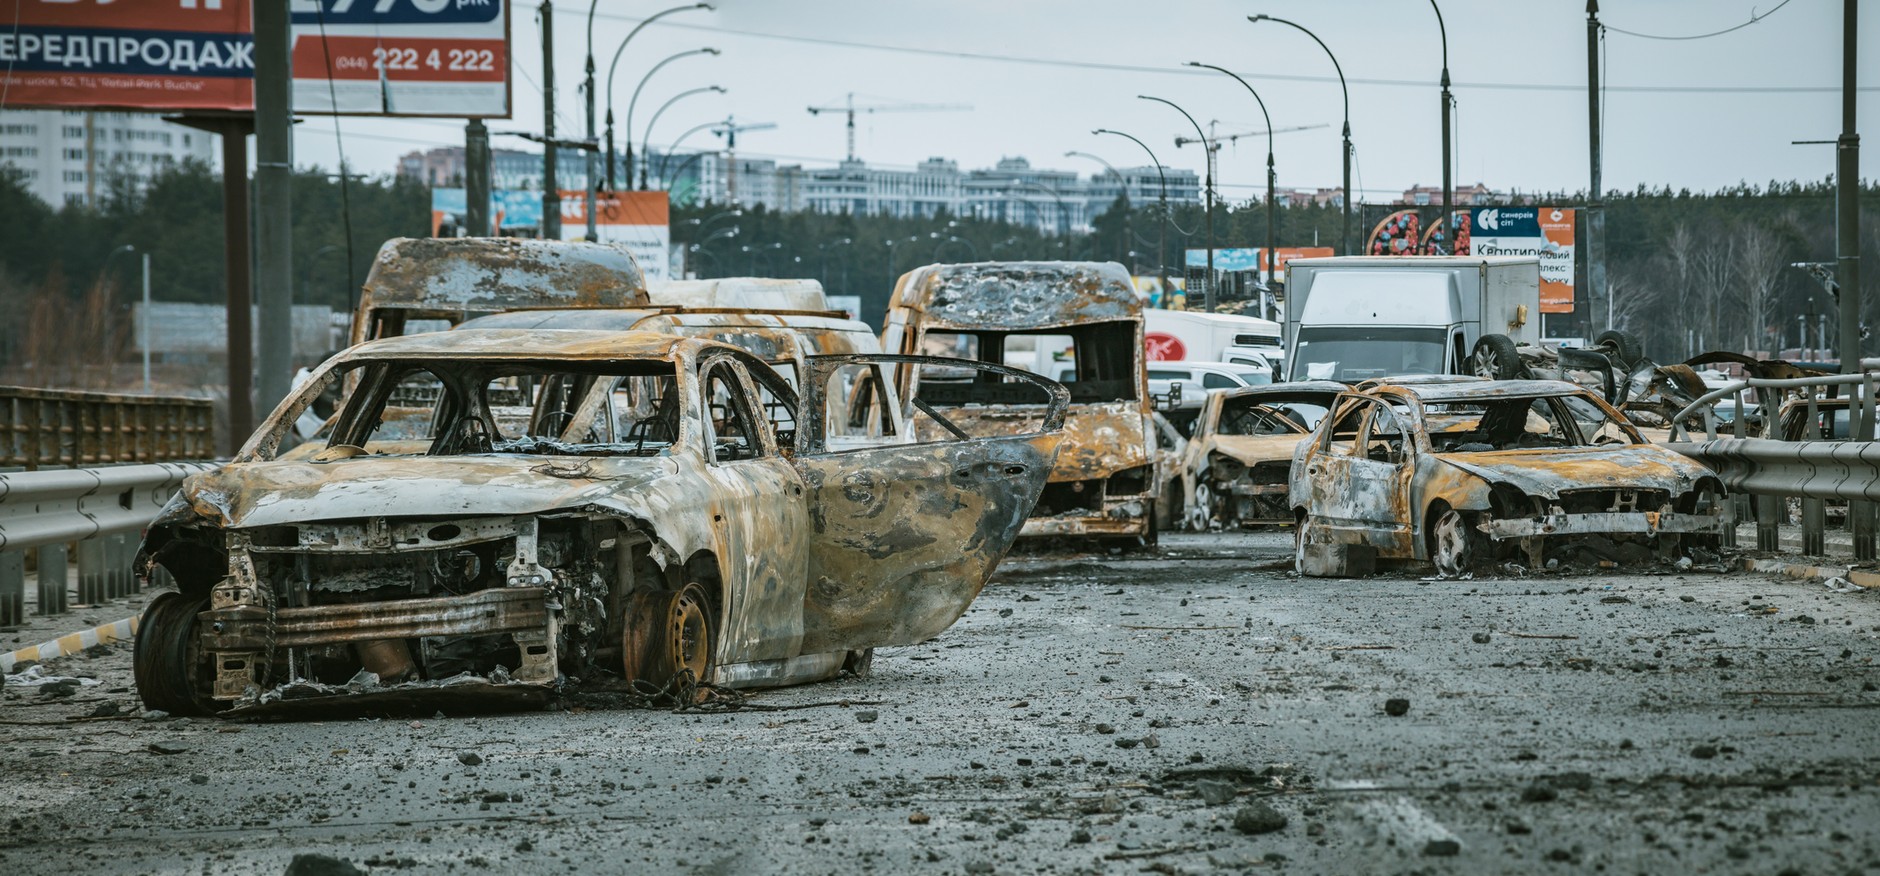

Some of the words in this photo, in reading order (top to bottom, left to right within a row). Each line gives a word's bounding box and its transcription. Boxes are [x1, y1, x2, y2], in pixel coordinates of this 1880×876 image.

[335, 56, 368, 70] (044)
[372, 47, 419, 70] 222
[425, 48, 442, 70] 4
[448, 49, 494, 71] 222
[136, 79, 161, 89] Park
[1500, 219, 1514, 227] сіті
